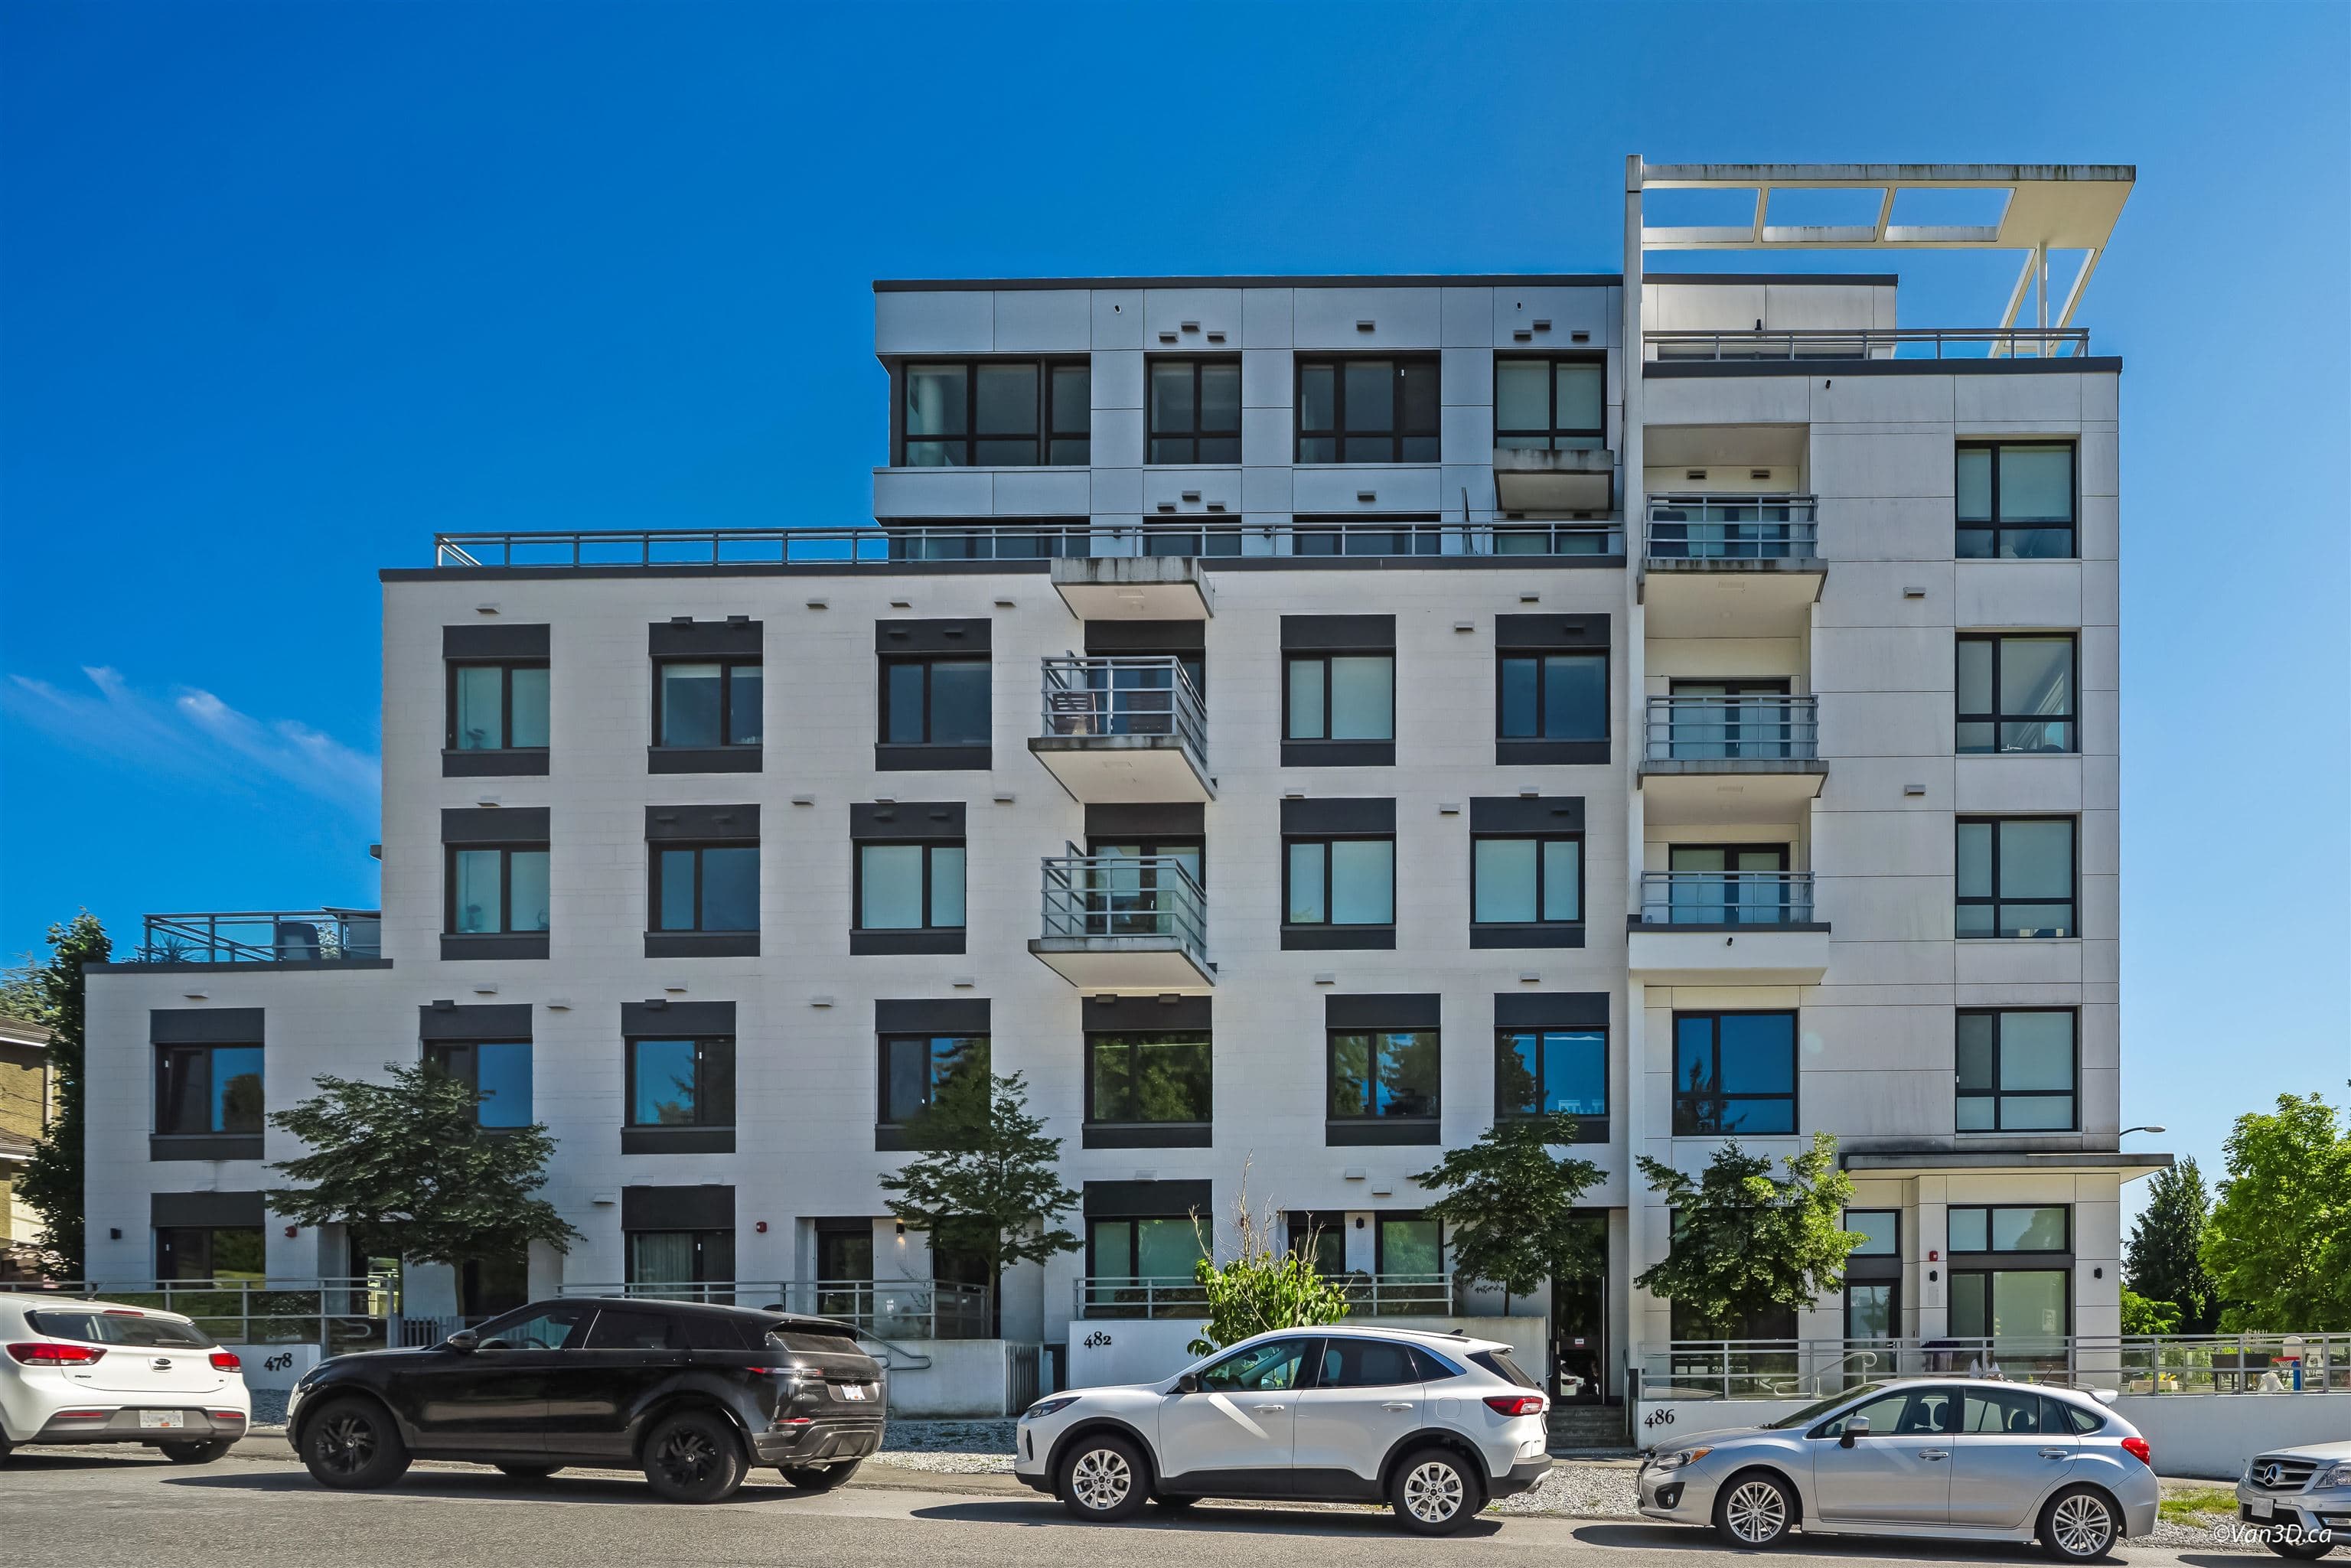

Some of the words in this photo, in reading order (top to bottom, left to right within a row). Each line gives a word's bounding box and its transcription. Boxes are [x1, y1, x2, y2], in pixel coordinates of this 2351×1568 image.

[1084, 1331, 1112, 1349] 482
[263, 1352, 292, 1371] 478
[1645, 1409, 1674, 1429] 486
